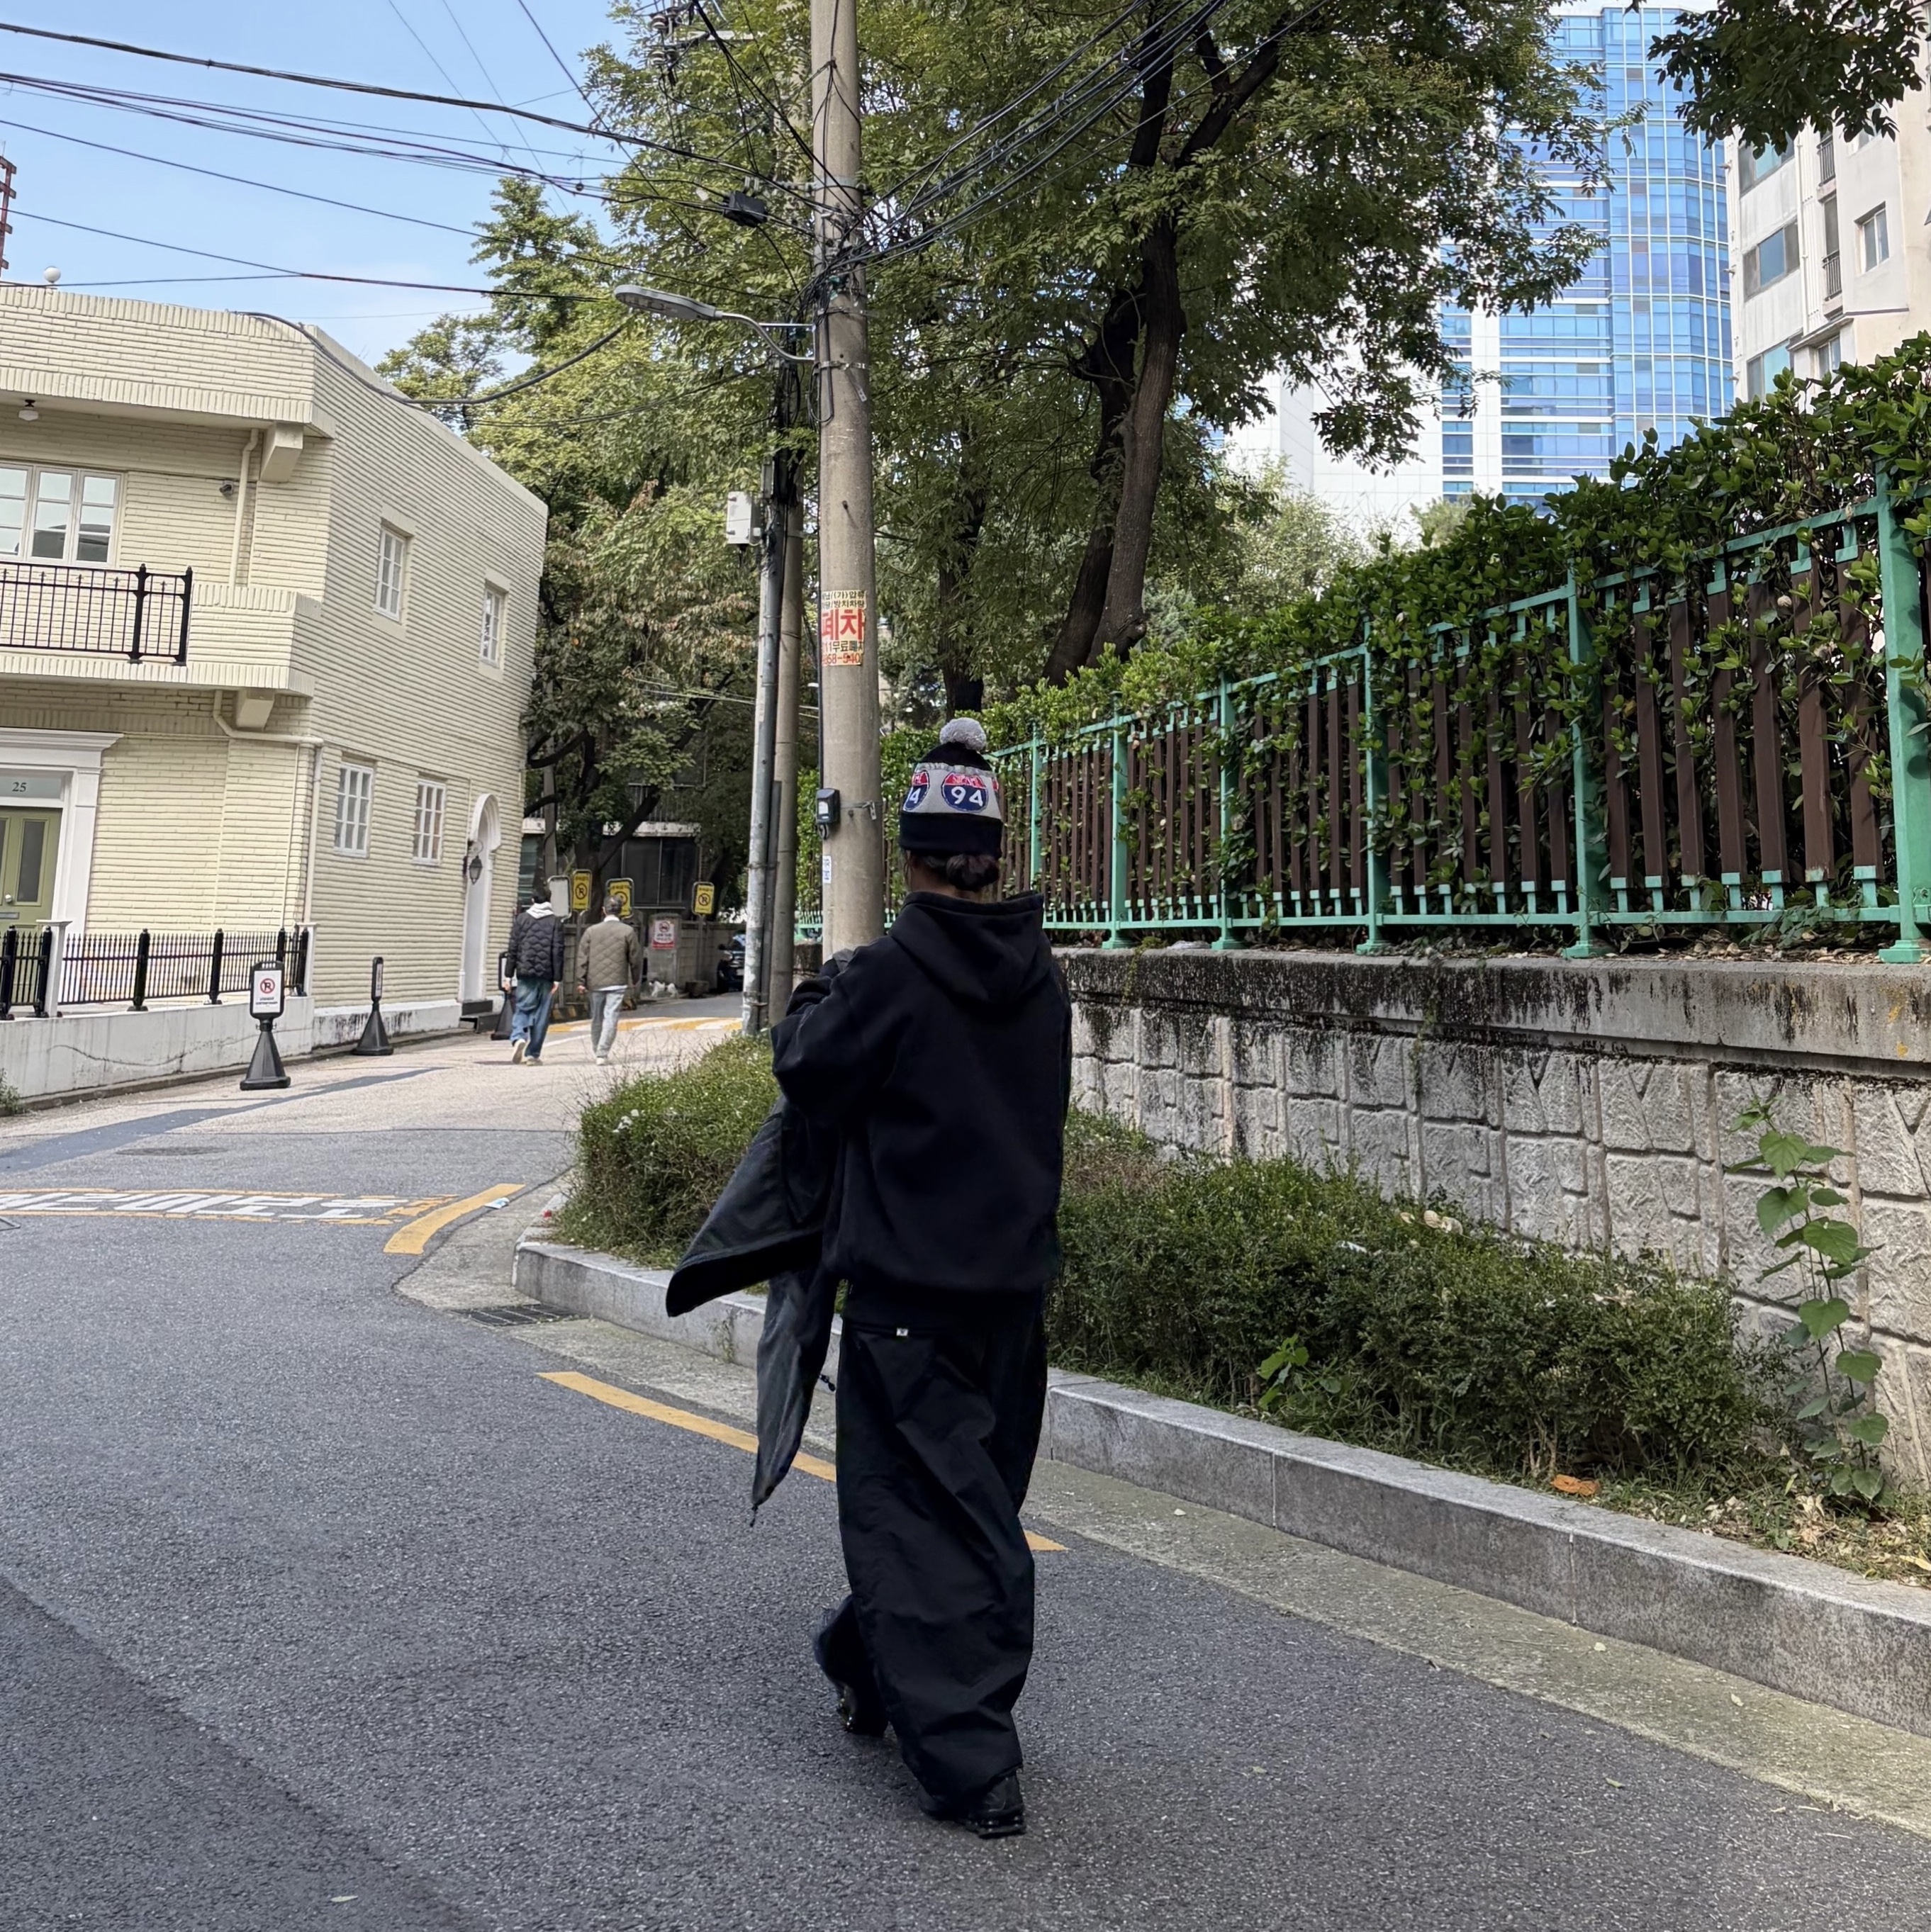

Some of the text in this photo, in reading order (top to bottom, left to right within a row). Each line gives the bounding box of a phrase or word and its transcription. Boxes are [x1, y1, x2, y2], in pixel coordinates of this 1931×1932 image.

[822, 608, 865, 641] 폐차
[12, 782, 27, 792] 25
[951, 786, 984, 807] 94
